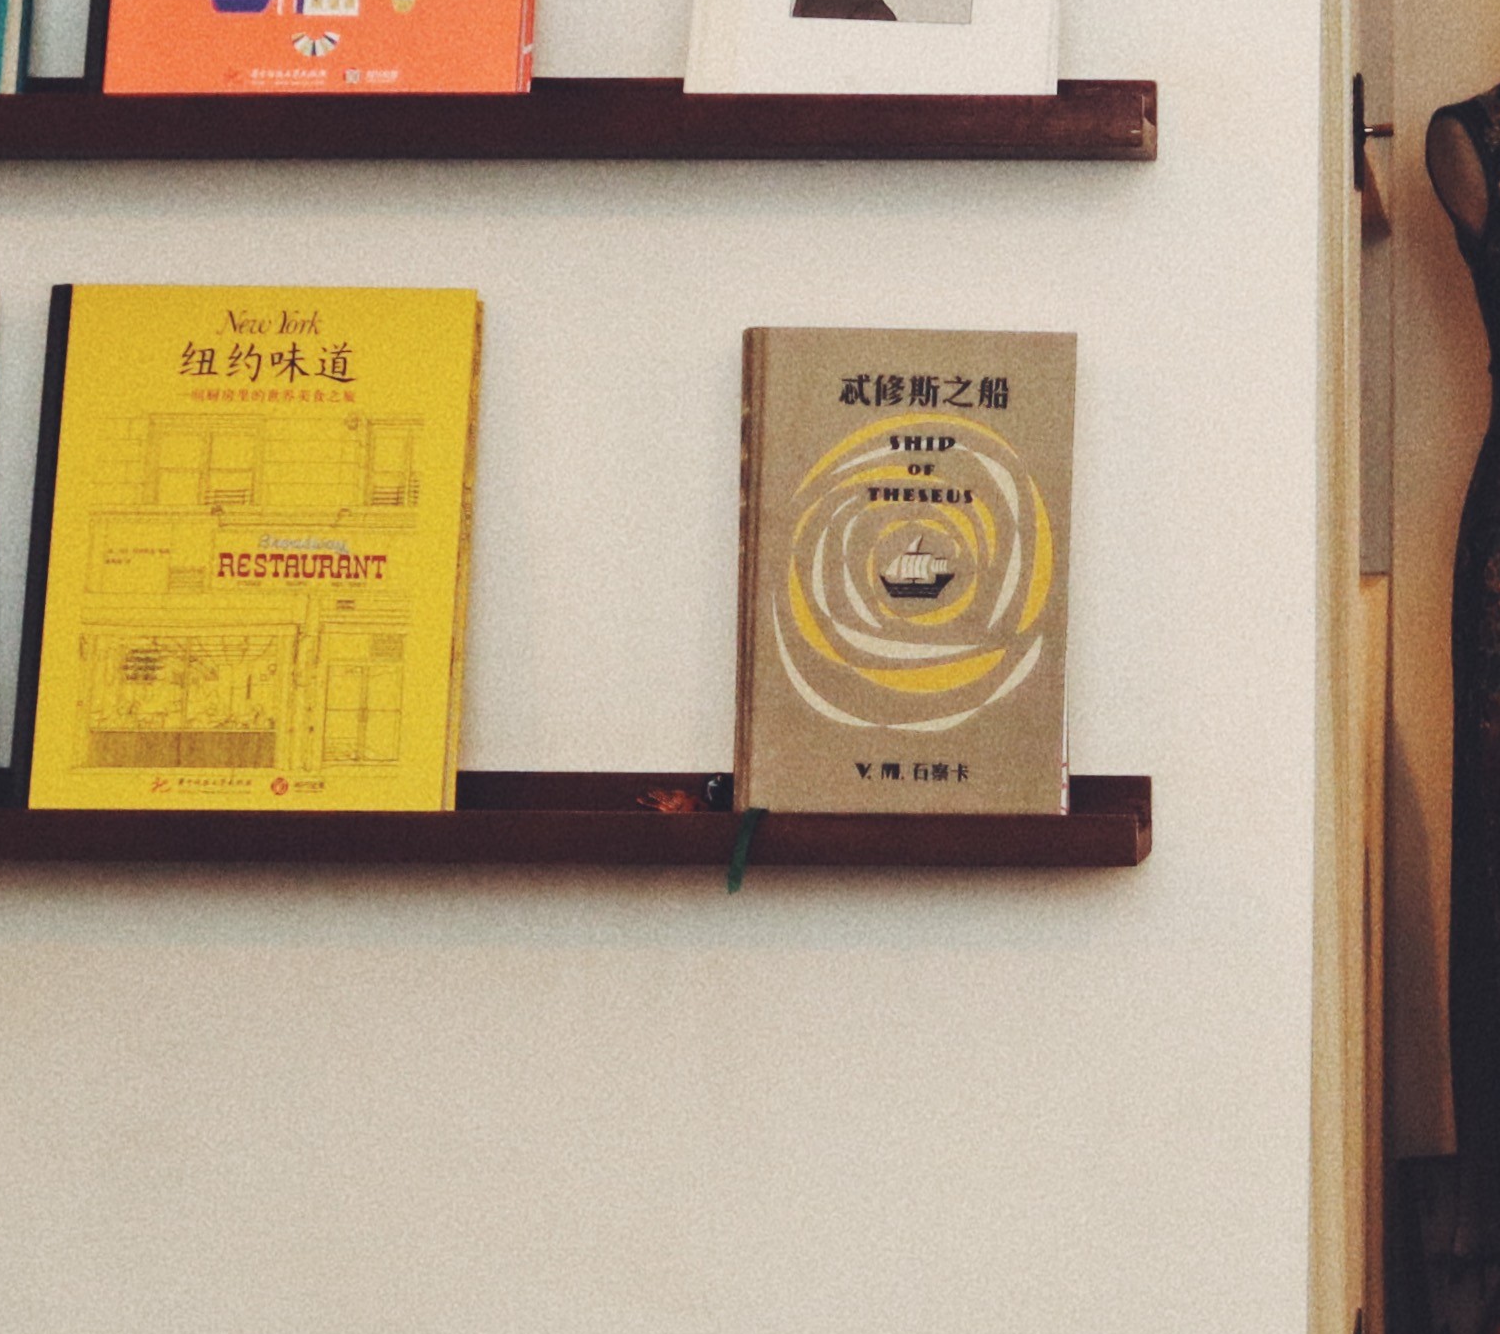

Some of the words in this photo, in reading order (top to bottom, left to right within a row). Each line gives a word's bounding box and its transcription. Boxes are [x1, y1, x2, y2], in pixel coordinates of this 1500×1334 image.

[216, 309, 272, 336] New
[275, 309, 323, 336] York
[179, 340, 358, 384] 纽约味道
[839, 374, 1010, 409] 忒修斯之船
[889, 435, 956, 452] SHIP
[907, 464, 935, 477] OF
[867, 486, 975, 505] THESEUS
[217, 553, 388, 580] RESTAURANT
[855, 762, 873, 781] V.
